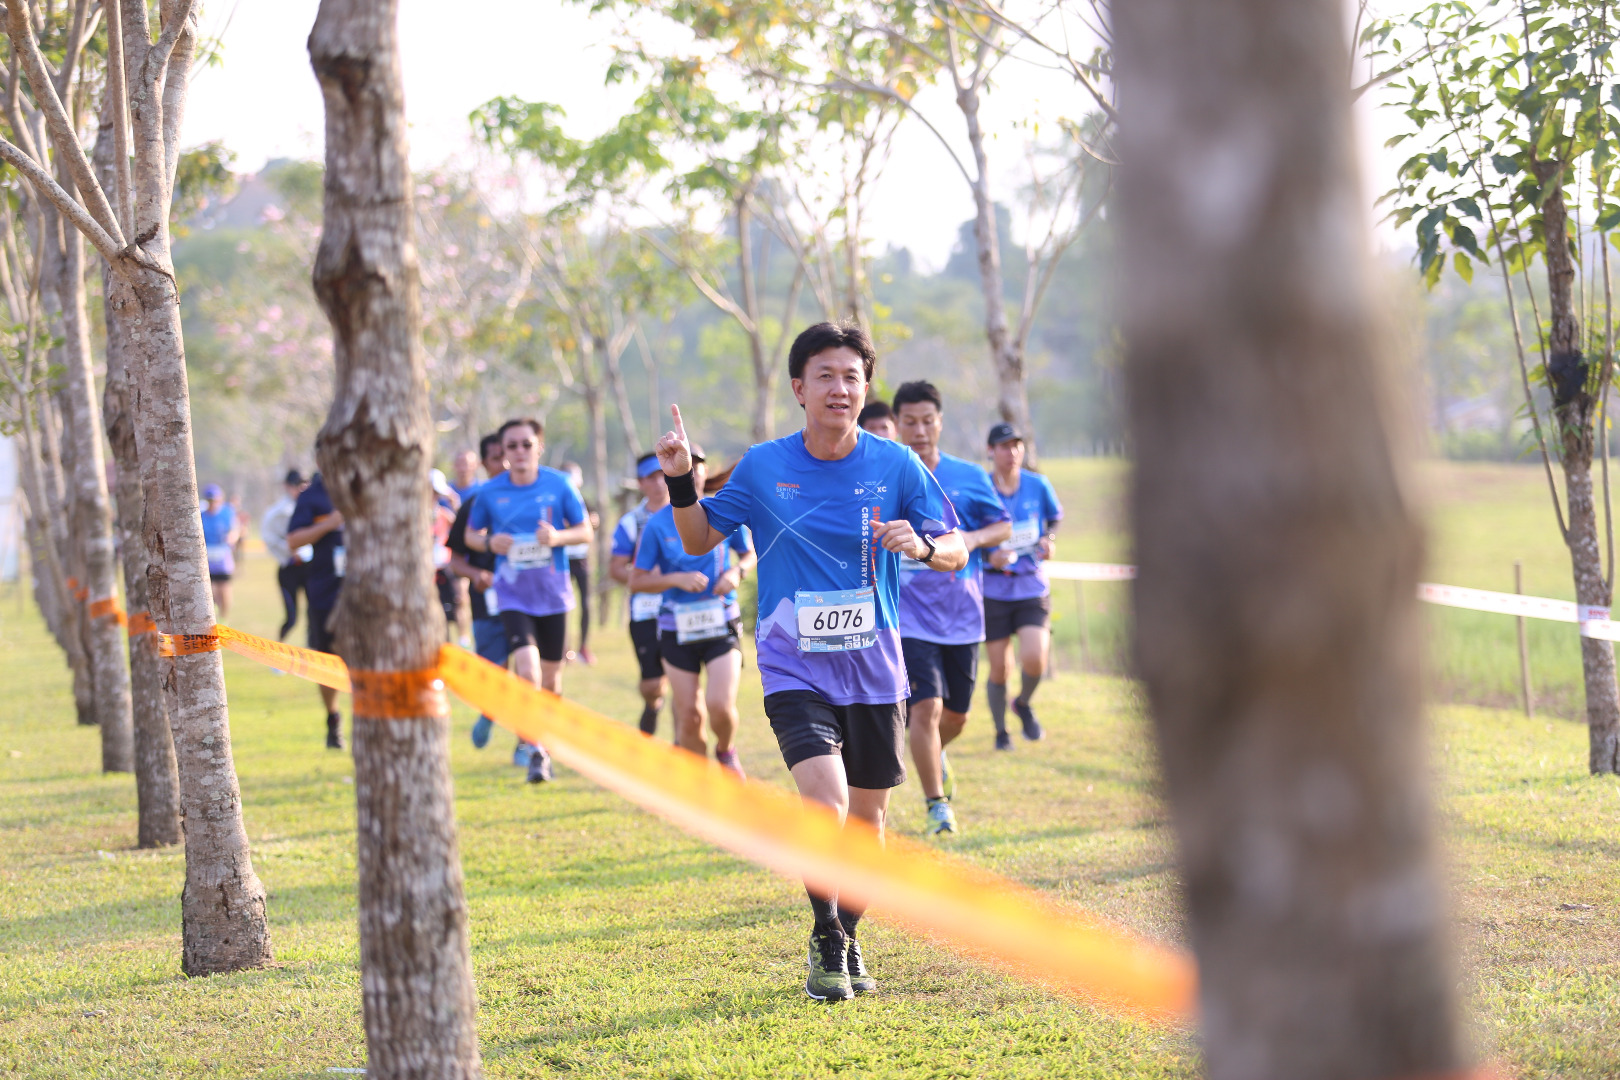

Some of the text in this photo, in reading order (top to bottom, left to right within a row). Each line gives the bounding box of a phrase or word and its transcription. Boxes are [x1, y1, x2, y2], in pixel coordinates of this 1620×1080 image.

[861, 507, 869, 536] CROSS
[861, 538, 869, 578] COUNTRY
[813, 608, 862, 630] 6076
